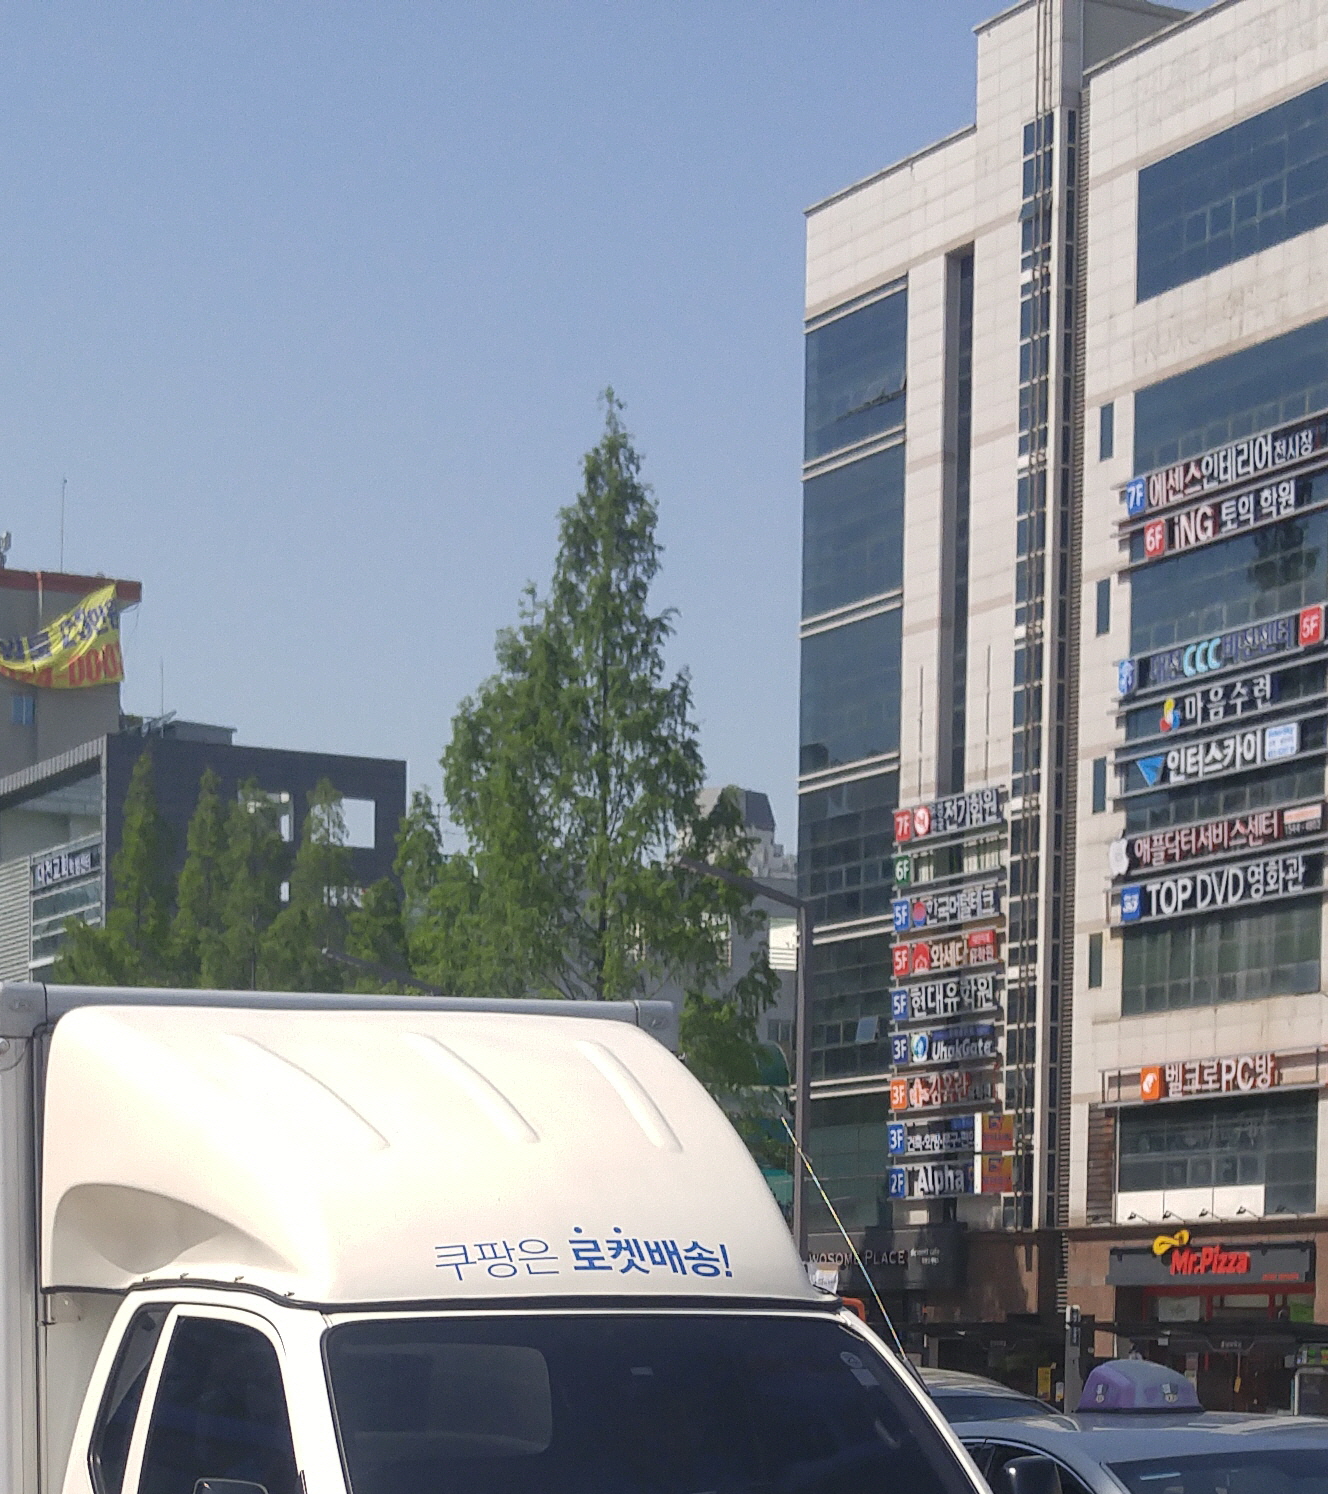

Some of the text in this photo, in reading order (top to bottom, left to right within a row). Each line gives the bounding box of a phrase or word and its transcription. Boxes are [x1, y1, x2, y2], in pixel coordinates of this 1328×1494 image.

[1127, 429, 1313, 509] 7F 에센스인테리어 전시장
[1146, 526, 1163, 551] 6F
[1260, 479, 1295, 517] 학원
[1183, 637, 1221, 677] CCC
[1302, 615, 1320, 639] 5F
[1184, 673, 1272, 726] 마음수련
[1167, 729, 1262, 783] 인터스카이
[1134, 810, 1278, 866] 애플닥터서비스센터
[895, 859, 909, 880] 6F
[1147, 876, 1194, 915] TOP
[1197, 866, 1244, 909] DVD
[1248, 854, 1306, 899] 영화관
[895, 904, 908, 926] 5F
[894, 950, 908, 971] 5F
[930, 938, 969, 970] 와세다
[894, 994, 907, 1015] 5F
[894, 1039, 907, 1060] 3F
[892, 1084, 905, 1105] 3F
[889, 1128, 903, 1149] 3F
[891, 1173, 904, 1194] 2F
[917, 1164, 965, 1196] Alpha
[434, 1226, 734, 1281] 쿠팡은 로켓배송!
[864, 1250, 906, 1265] PLACE
[1169, 1244, 1251, 1276] Mr.Pizza
